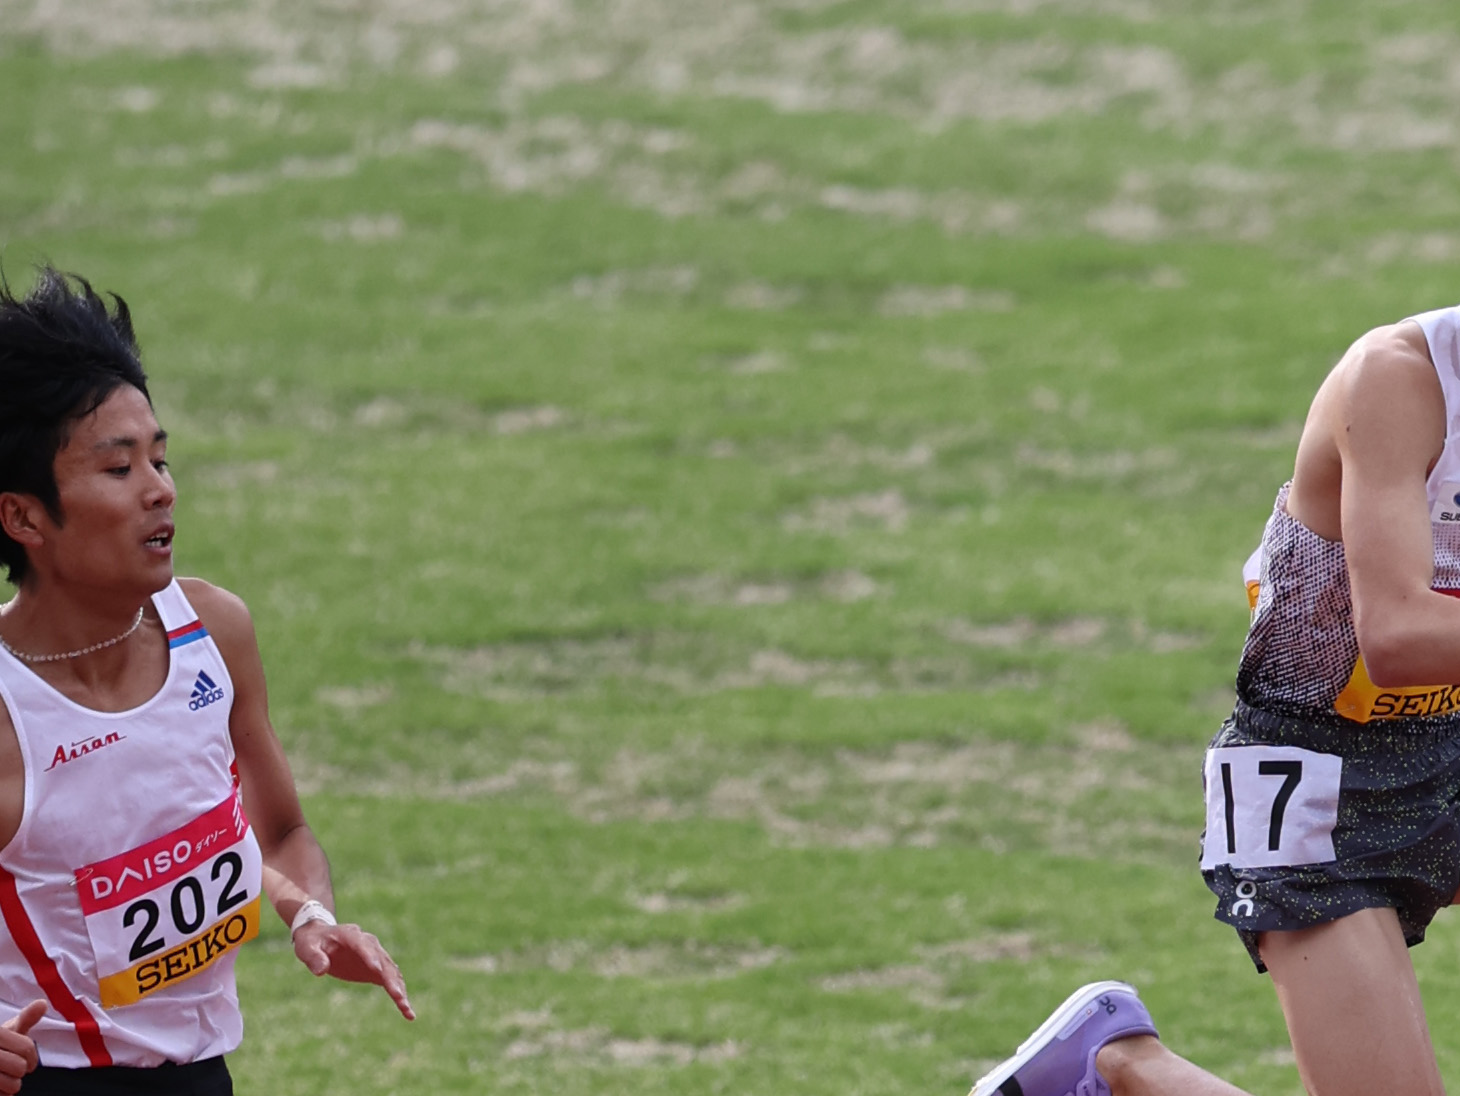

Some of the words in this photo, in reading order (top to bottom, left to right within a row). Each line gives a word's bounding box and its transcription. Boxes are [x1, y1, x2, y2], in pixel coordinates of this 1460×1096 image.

[188, 687, 224, 711] adidas
[45, 732, 127, 772] Aisan
[1221, 760, 1302, 854] 17
[91, 840, 191, 899] DAISO
[122, 851, 248, 962] 202
[136, 914, 247, 994] SEIKO
